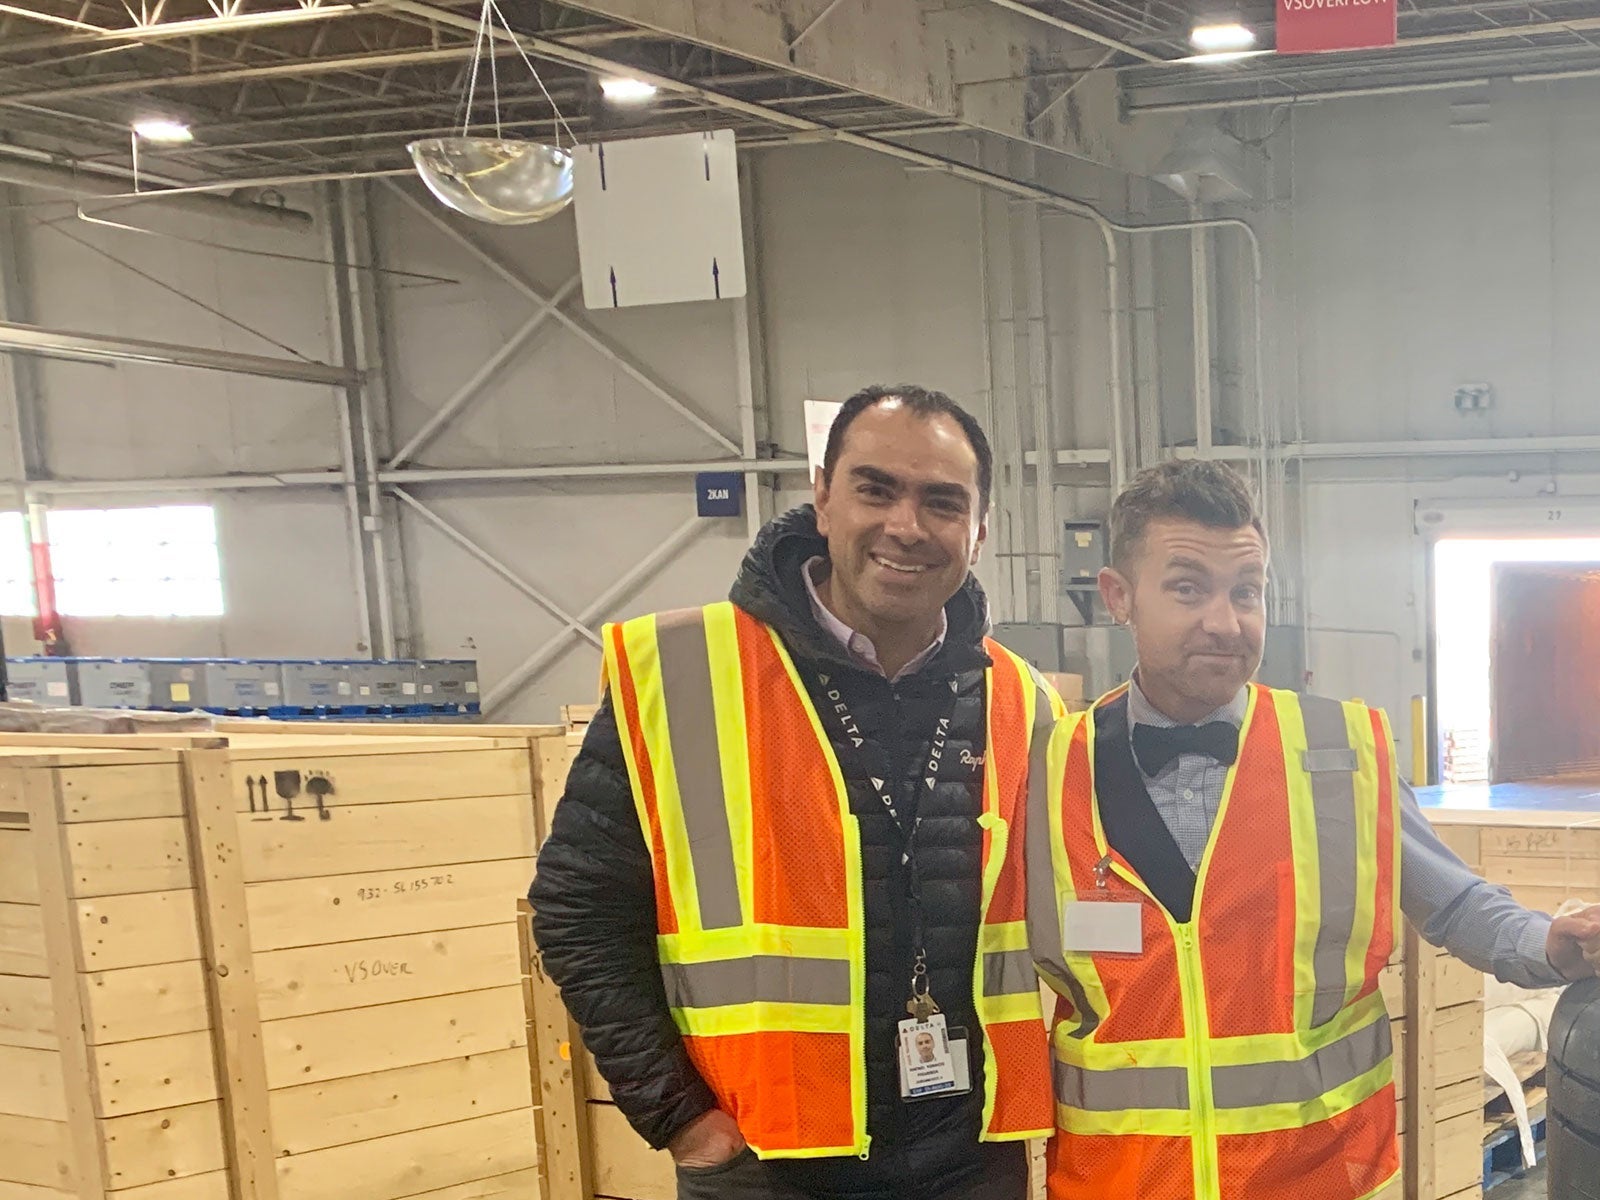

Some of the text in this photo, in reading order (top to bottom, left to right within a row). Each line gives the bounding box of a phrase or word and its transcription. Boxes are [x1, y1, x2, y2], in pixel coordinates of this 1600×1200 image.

[827, 689, 865, 748] DELTA
[928, 717, 950, 772] DELTA
[881, 794, 900, 825] DE
